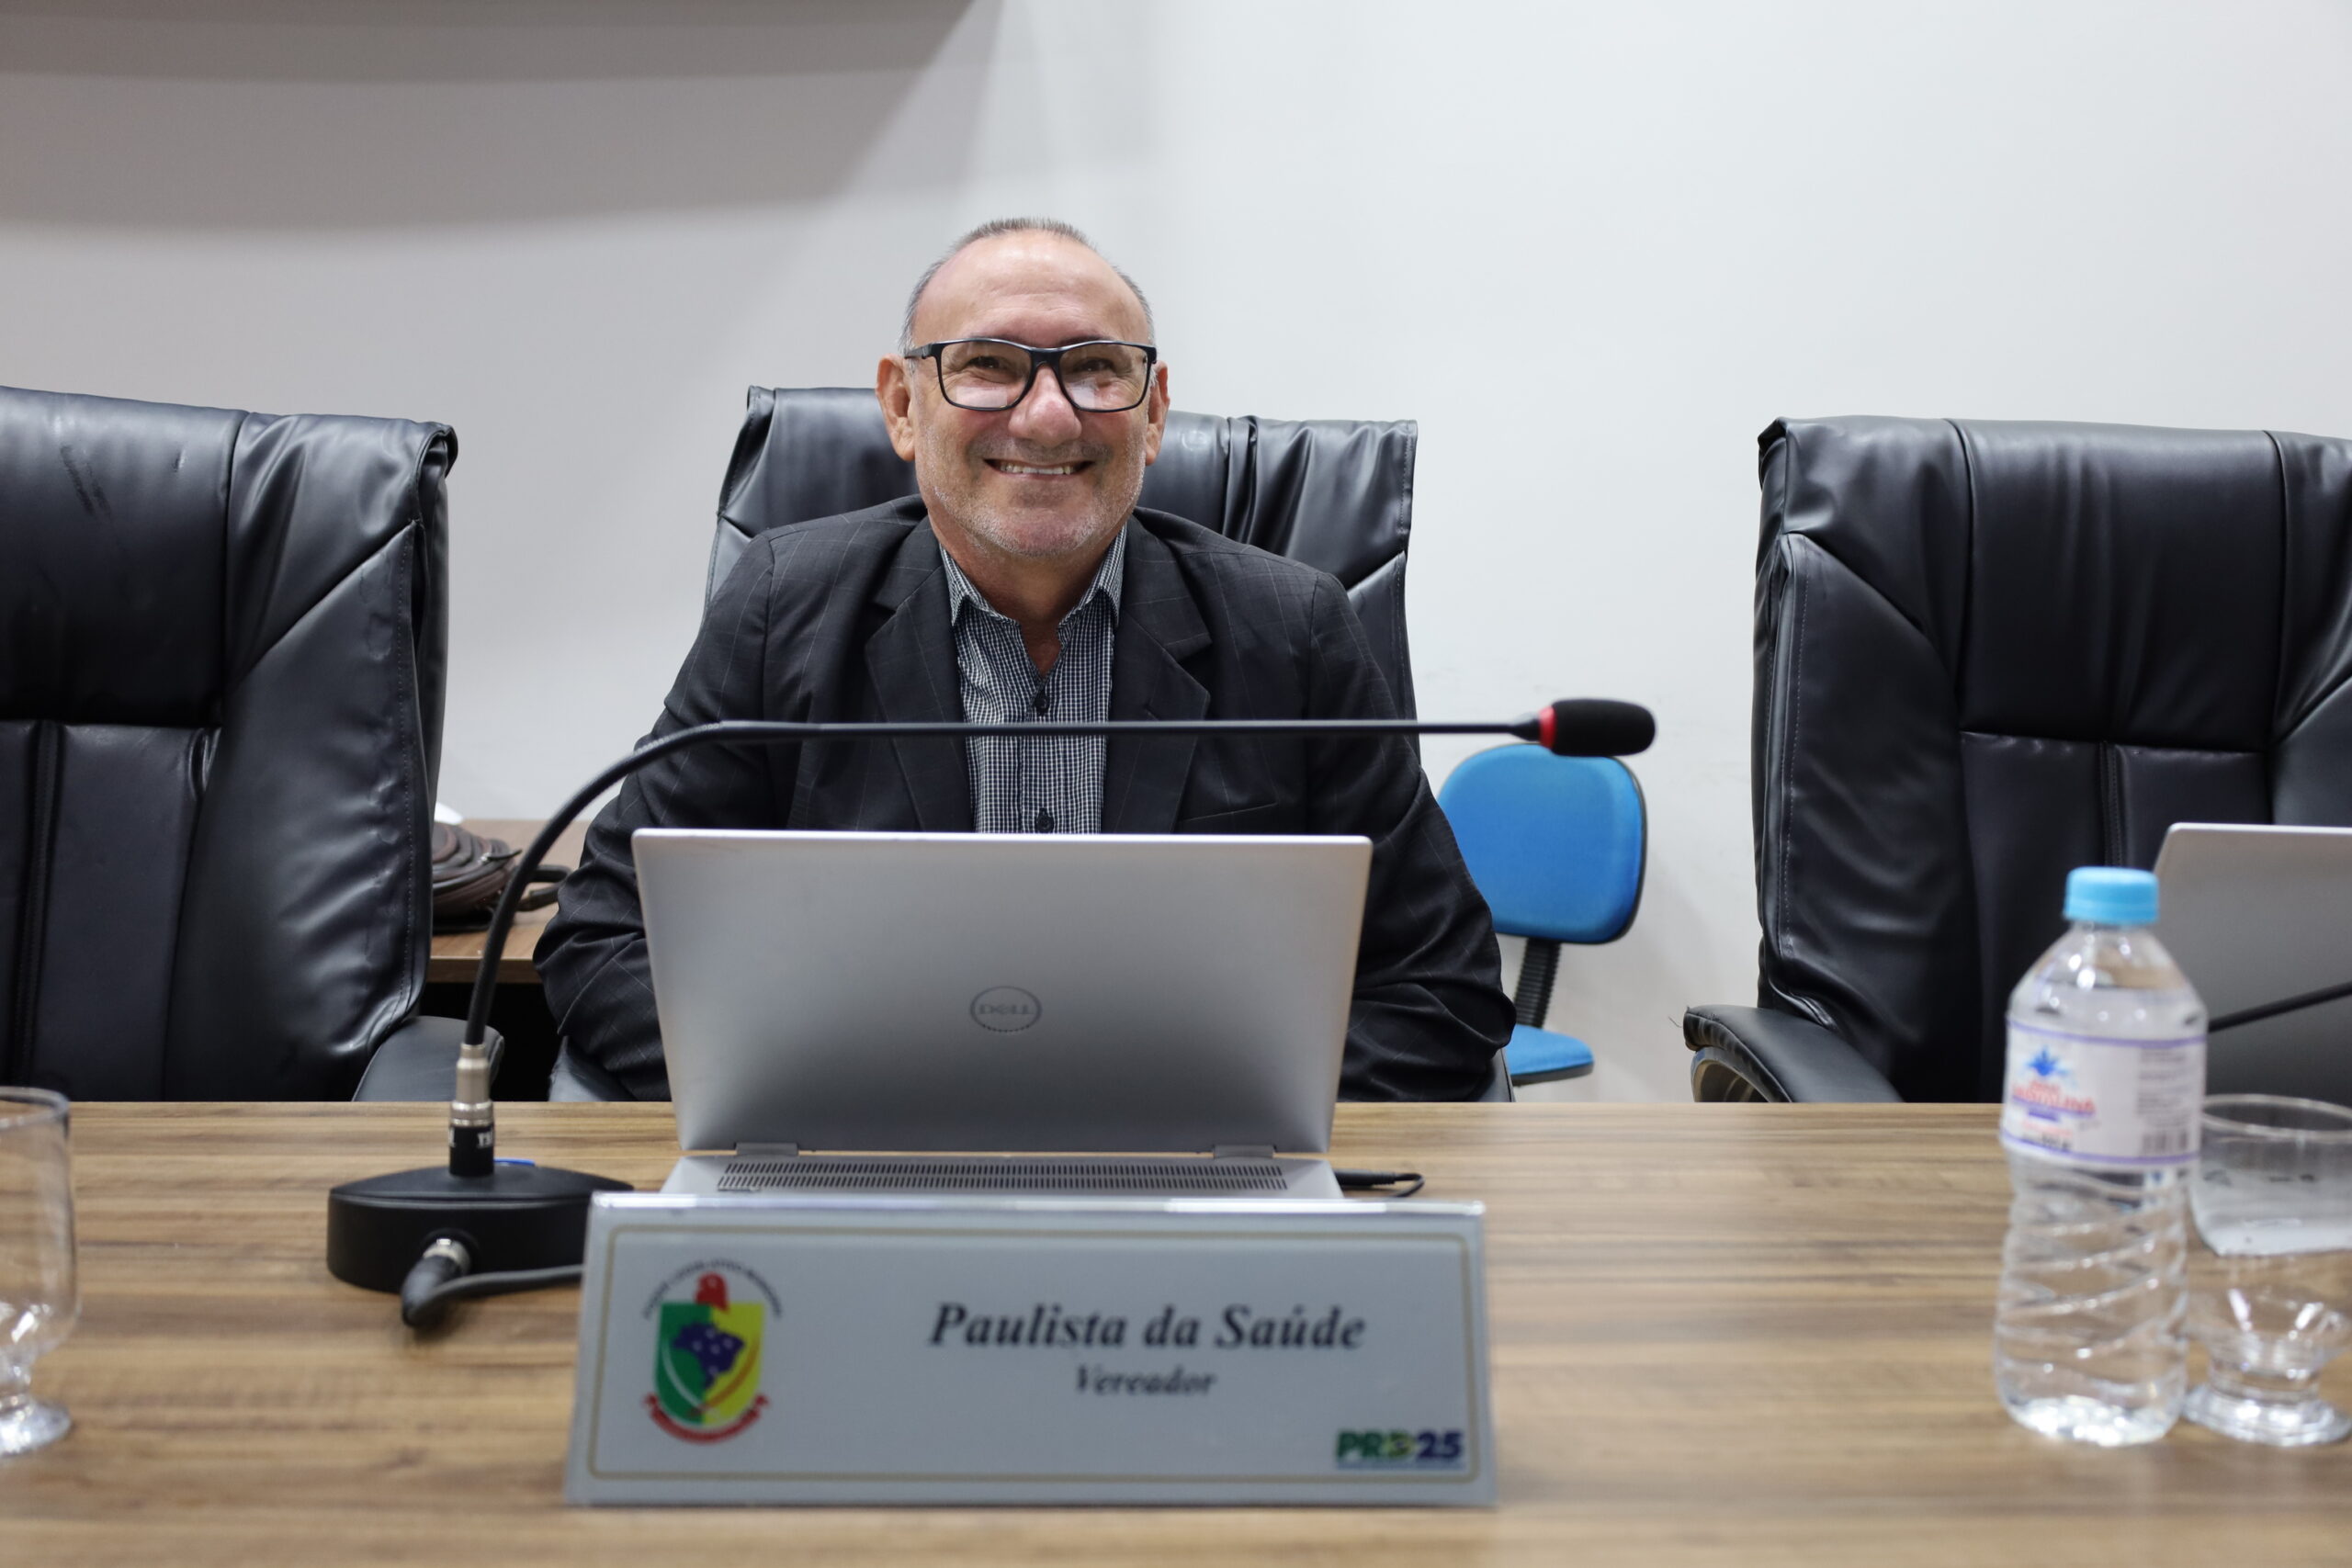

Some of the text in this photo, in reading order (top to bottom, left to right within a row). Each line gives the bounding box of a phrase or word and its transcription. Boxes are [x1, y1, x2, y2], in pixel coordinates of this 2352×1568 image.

[978, 1003, 1035, 1015] DELL
[929, 1302, 1366, 1349] Paulista da Saúde
[1077, 1363, 1216, 1394] Vereador
